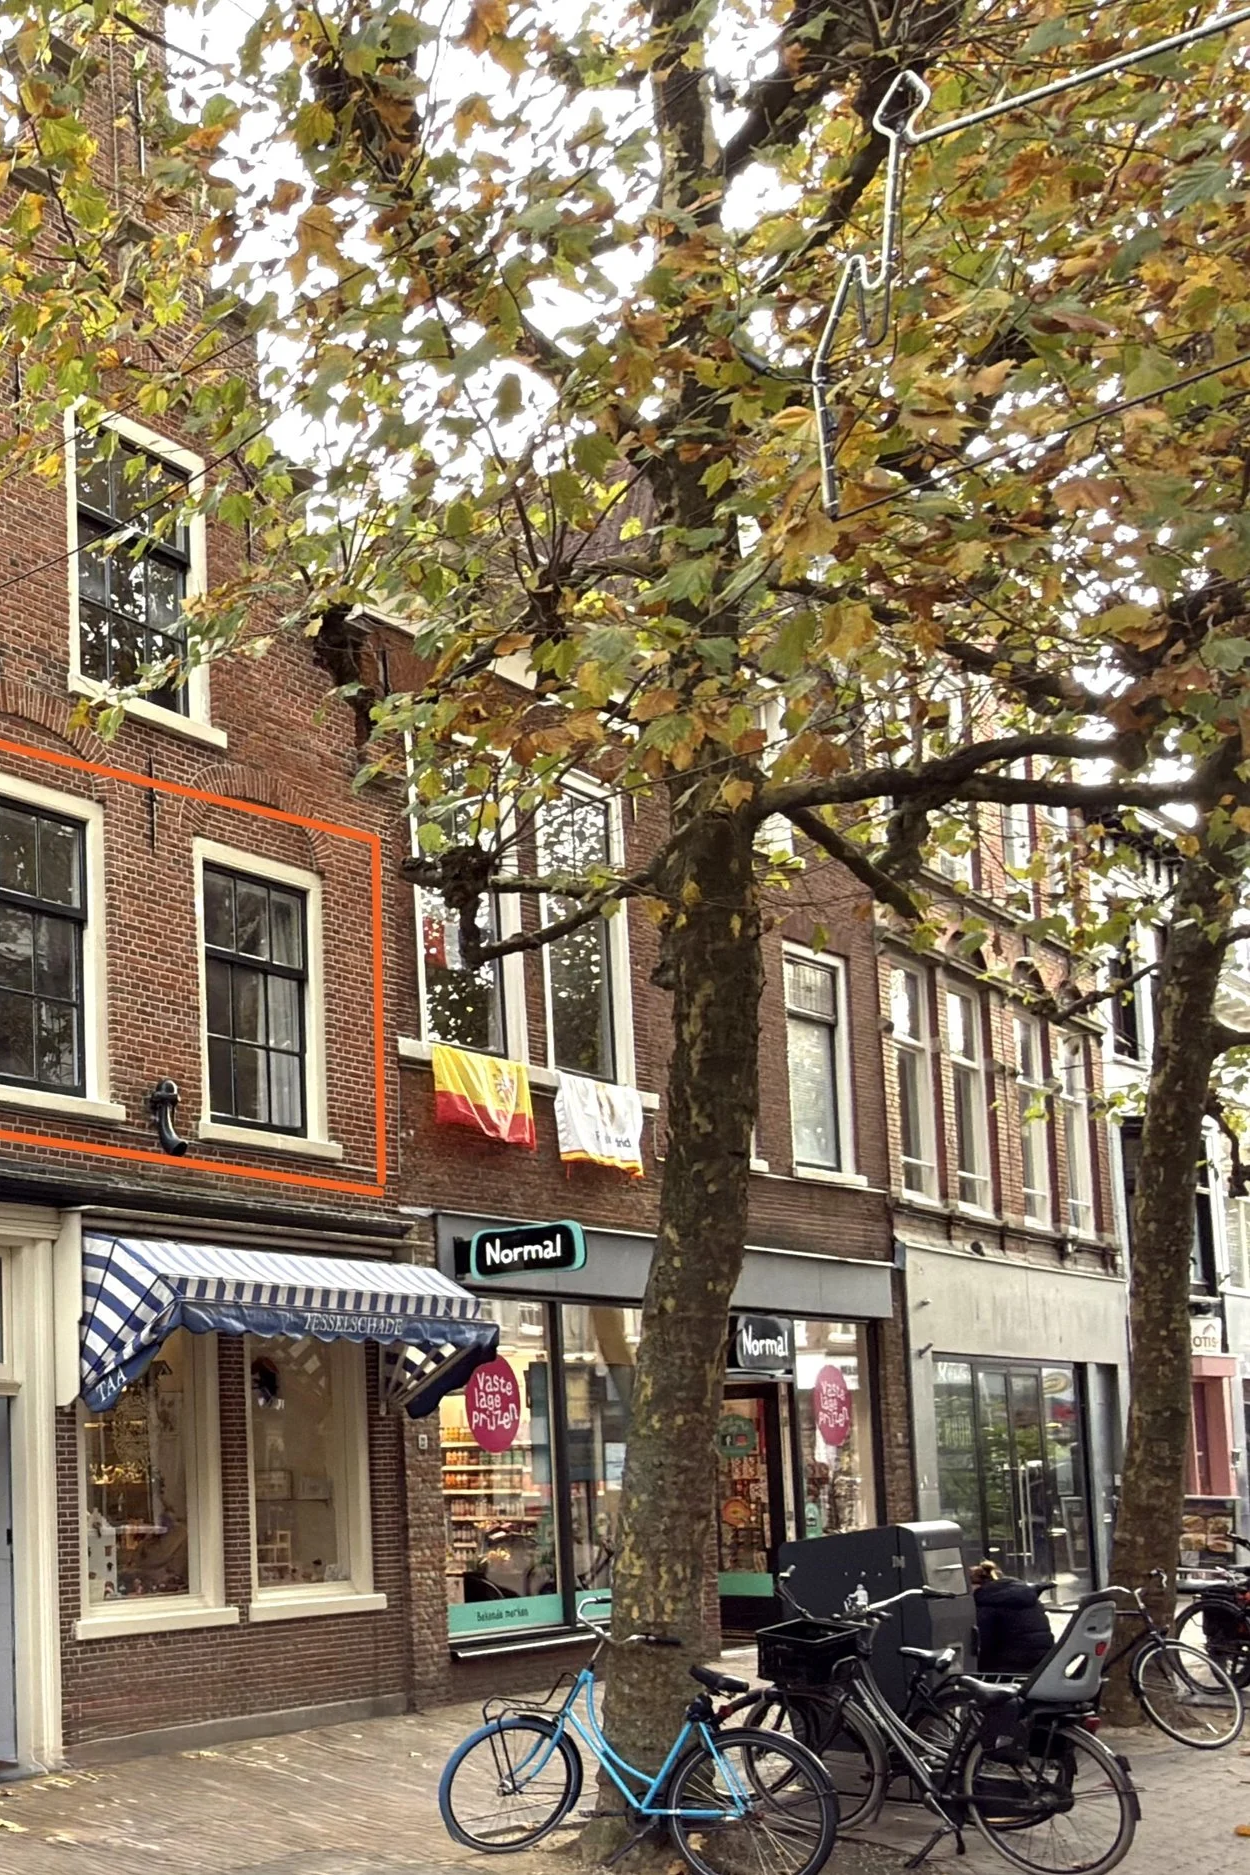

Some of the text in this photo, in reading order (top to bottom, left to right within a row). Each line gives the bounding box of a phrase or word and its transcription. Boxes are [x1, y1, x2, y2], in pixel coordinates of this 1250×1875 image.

[485, 1233, 561, 1266] Normal
[304, 1312, 403, 1335] TESSELSCHADE
[742, 1325, 789, 1357] Normal
[95, 1366, 128, 1402] TAA
[477, 1372, 513, 1396] Vaste
[821, 1381, 846, 1401] Vaste
[474, 1387, 502, 1411] lage
[472, 1403, 519, 1431] prijzen
[476, 1608, 529, 1622] Bekende merken
